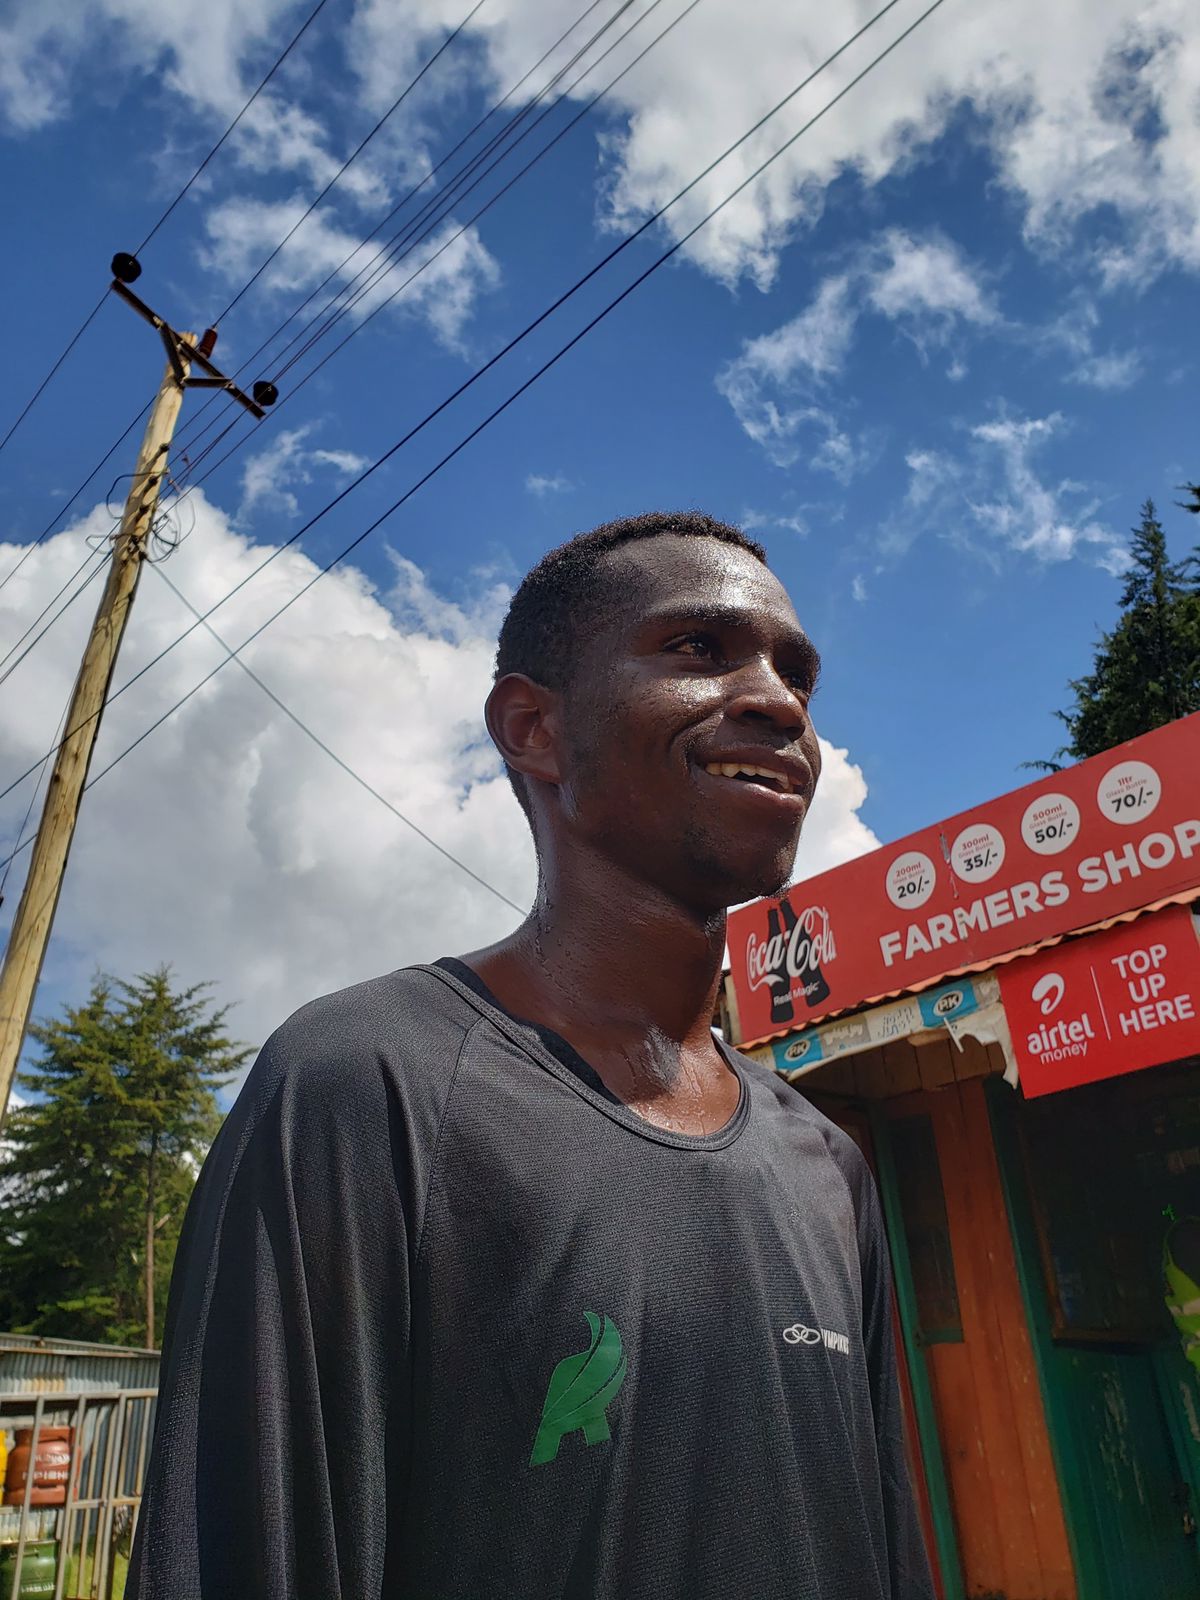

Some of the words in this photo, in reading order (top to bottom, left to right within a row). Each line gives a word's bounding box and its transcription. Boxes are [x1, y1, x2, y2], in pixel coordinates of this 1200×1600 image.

[1032, 803, 1063, 821] 500ml
[962, 833, 990, 851] 300ml
[896, 861, 922, 878] 200ml
[879, 870, 1071, 968] FARMERS
[1077, 819, 1200, 893] SHOP
[746, 905, 837, 992] Coca-Cola
[1111, 943, 1167, 979] TOP
[773, 991, 793, 1007] Real
[792, 982, 819, 999] Magic
[1127, 973, 1166, 1004] UP
[1118, 993, 1196, 1037] HERE
[1027, 1012, 1095, 1055] airtel
[1040, 1041, 1088, 1065] money
